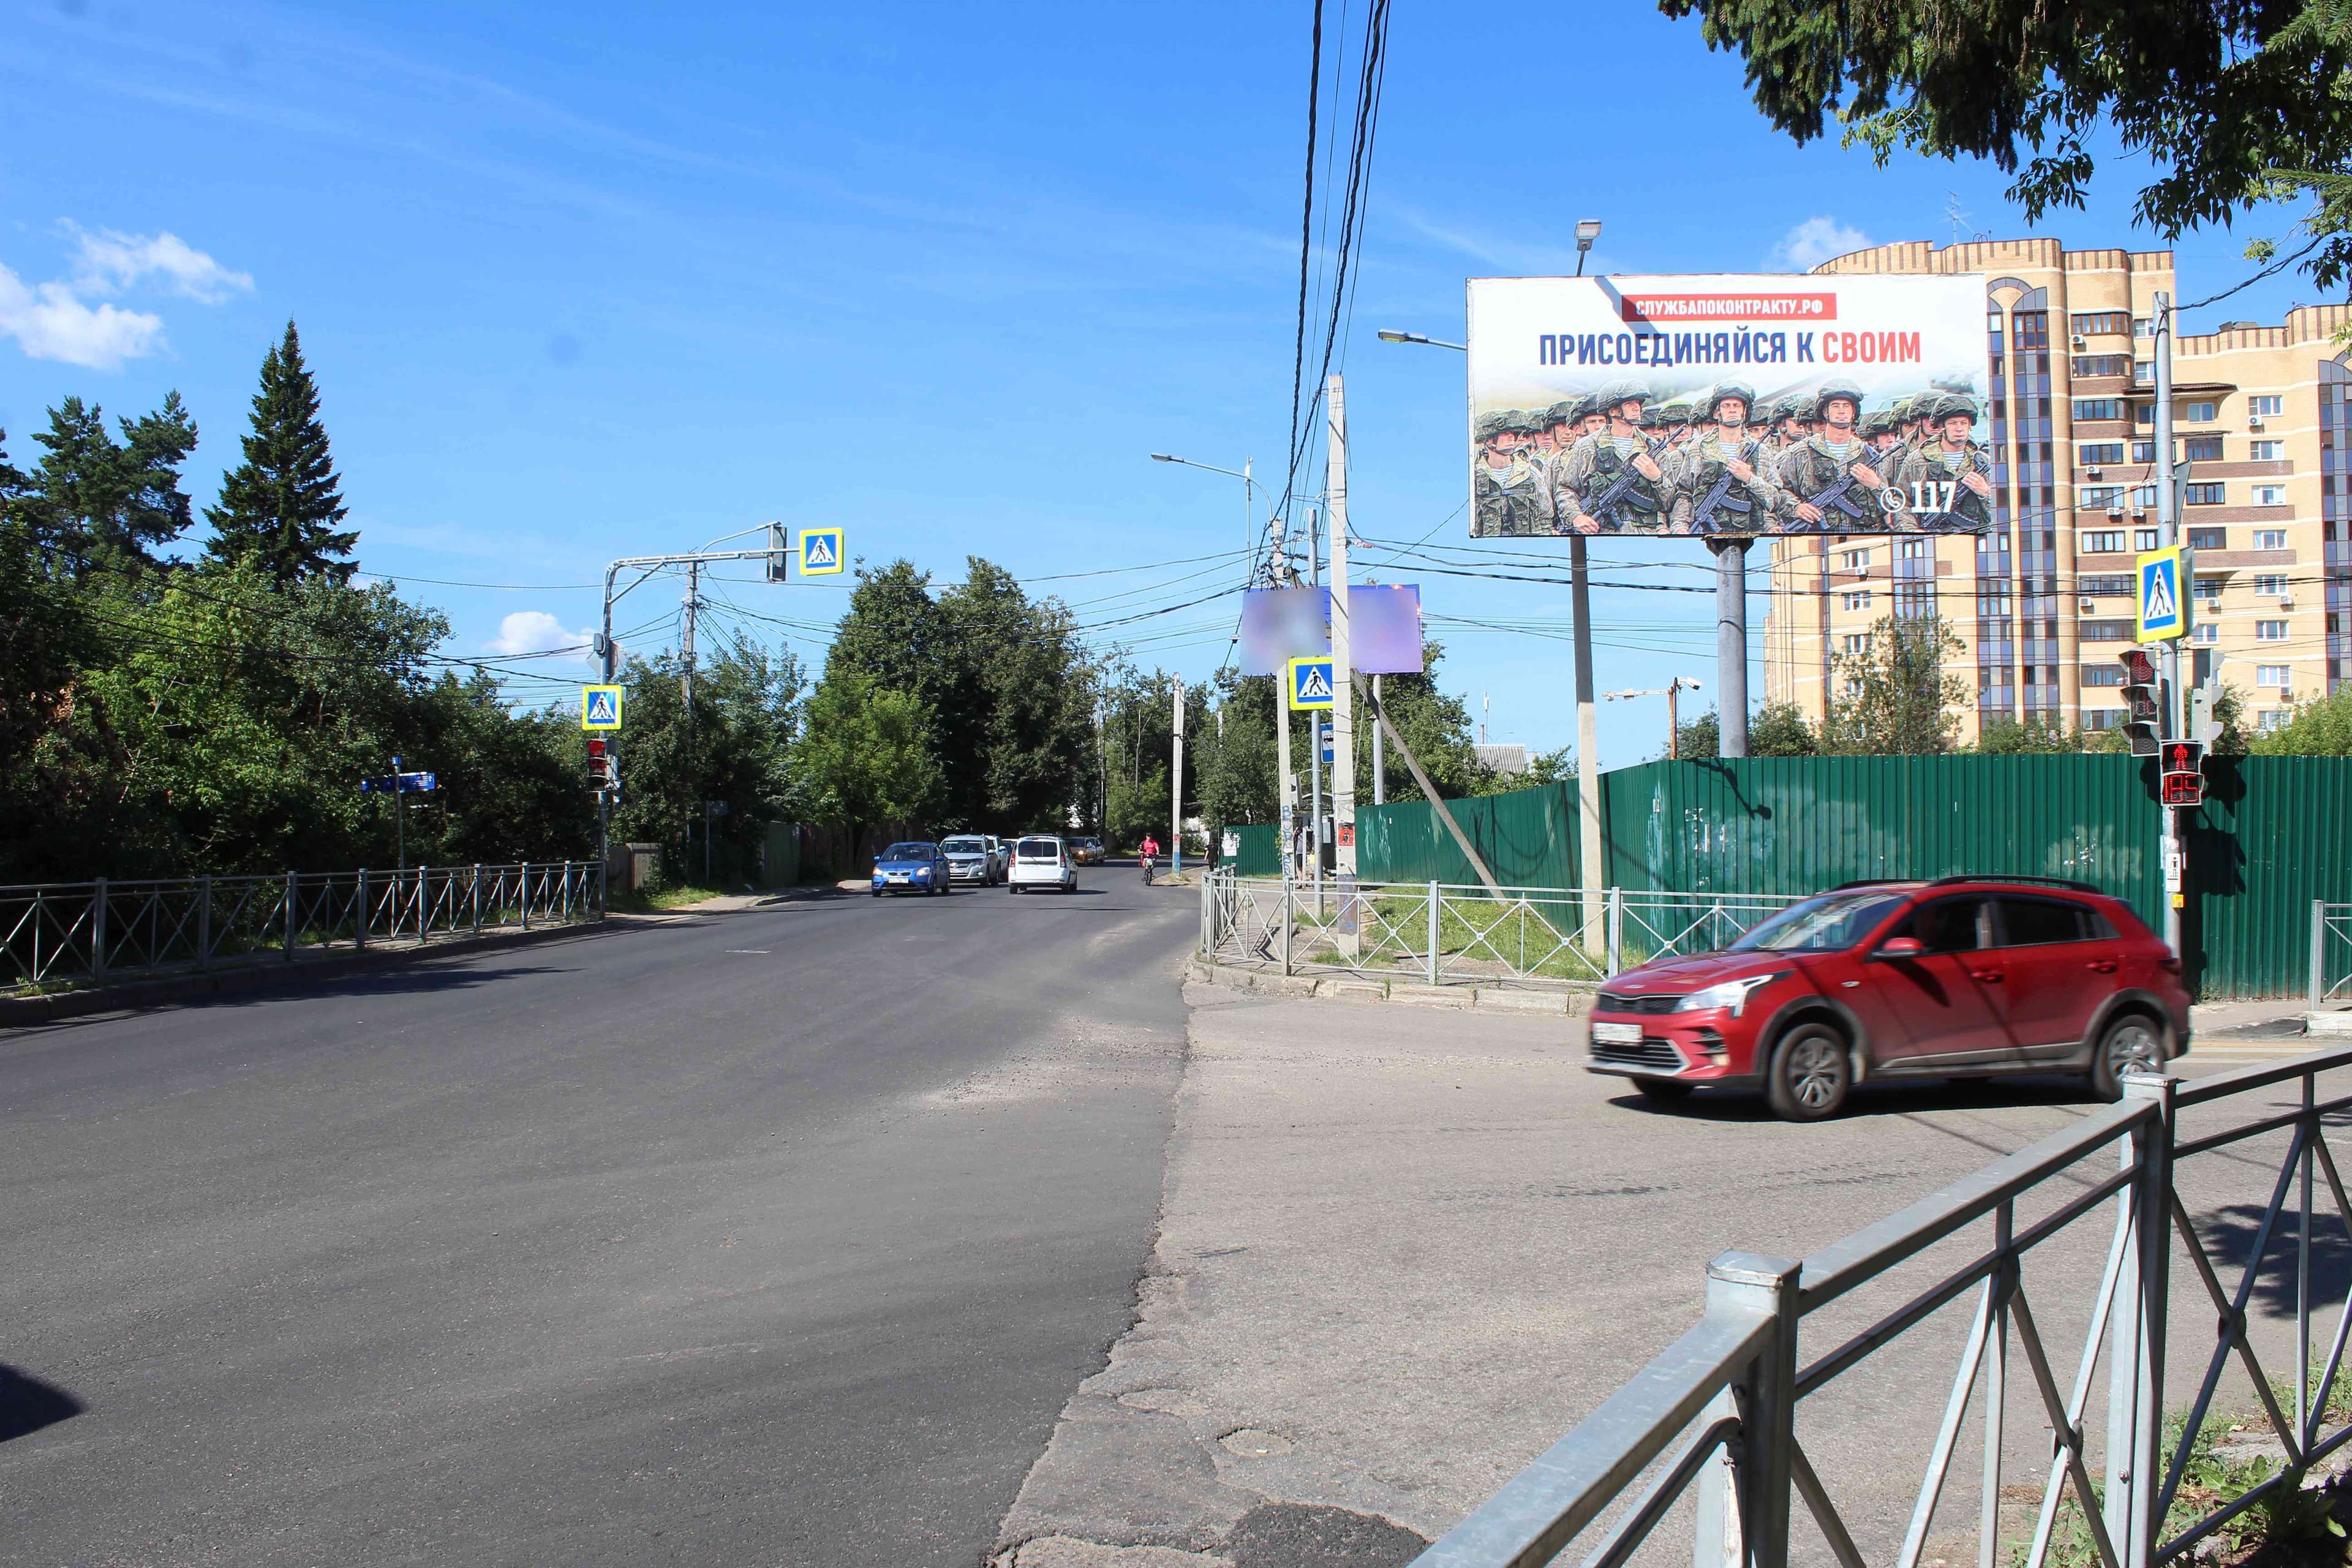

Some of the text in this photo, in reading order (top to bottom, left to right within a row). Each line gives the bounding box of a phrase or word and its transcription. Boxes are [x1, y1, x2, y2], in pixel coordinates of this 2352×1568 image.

[1635, 299, 1823, 315] СЛУЖБАПОКОНТРАКТУ.РФ
[1539, 325, 1921, 368] ПРИСОЕДИНЯЙСЯ К СВОИМ
[1910, 480, 1957, 513] 117
[2164, 774, 2199, 803] 185
